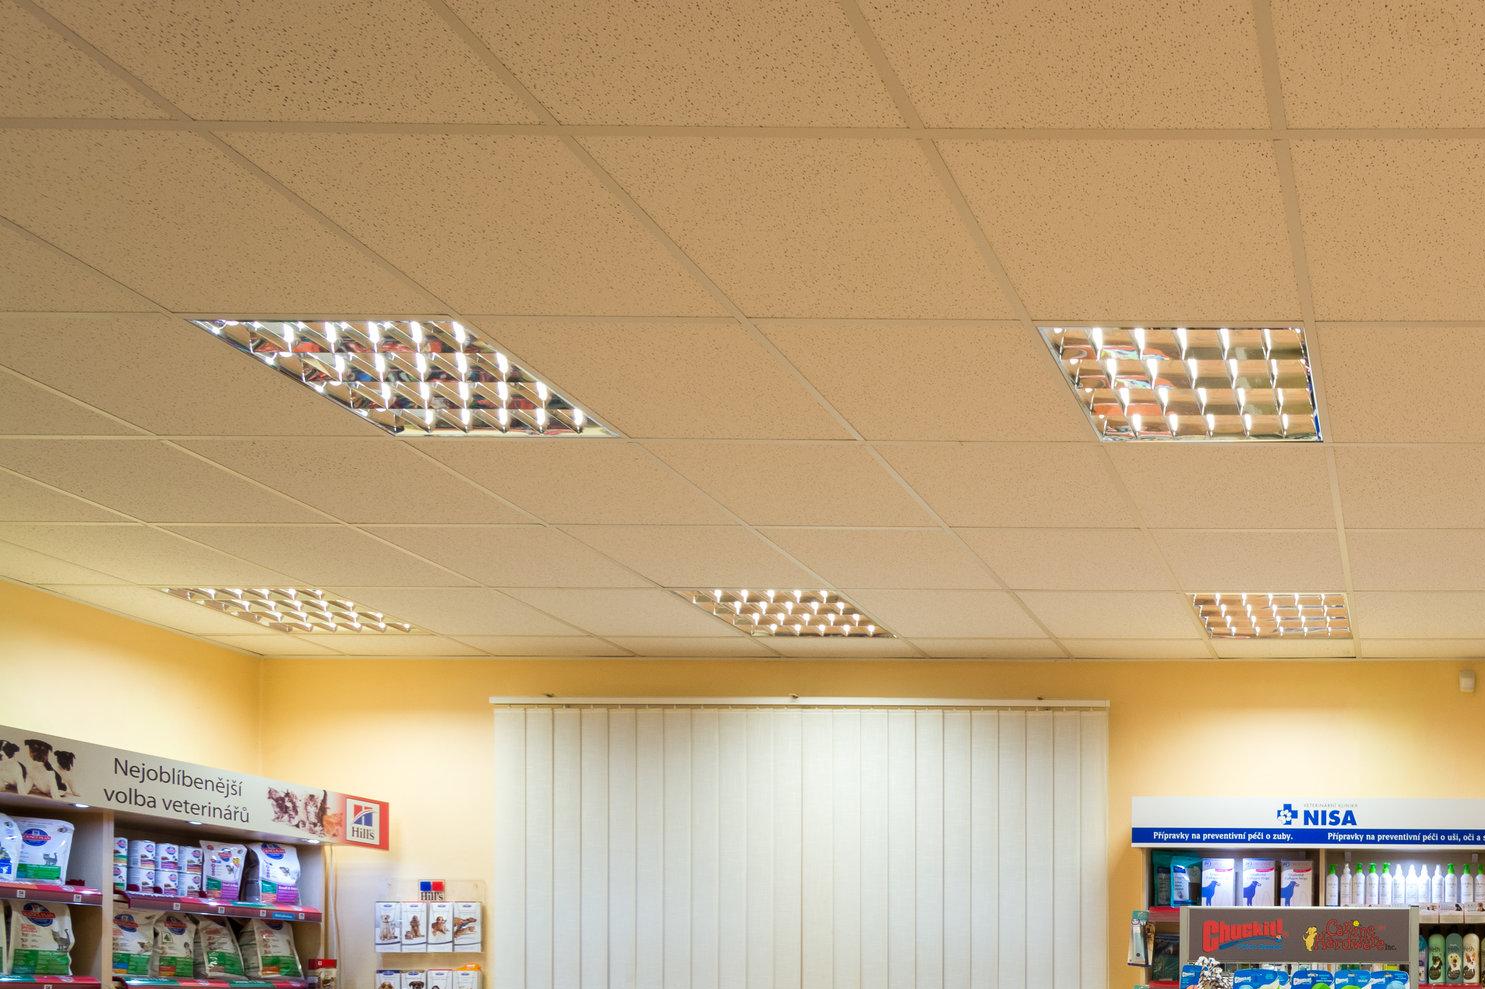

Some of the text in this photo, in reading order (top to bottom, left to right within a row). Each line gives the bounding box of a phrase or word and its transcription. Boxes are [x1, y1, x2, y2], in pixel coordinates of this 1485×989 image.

[114, 757, 243, 797] Nejoblíbenější
[103, 787, 250, 824] volba veterinářů
[1303, 809, 1357, 826] NISA
[351, 826, 375, 841] Hill's
[1153, 831, 1189, 842] Přípravky
[1202, 831, 1246, 841] preventivní
[1248, 831, 1264, 841] péči
[1272, 831, 1294, 841] zuby.
[1327, 832, 1364, 842] Přípravky
[1377, 832, 1421, 842] preventivní
[1422, 832, 1439, 842] péči
[1447, 833, 1461, 842] uši,
[1463, 833, 1475, 841] oči
